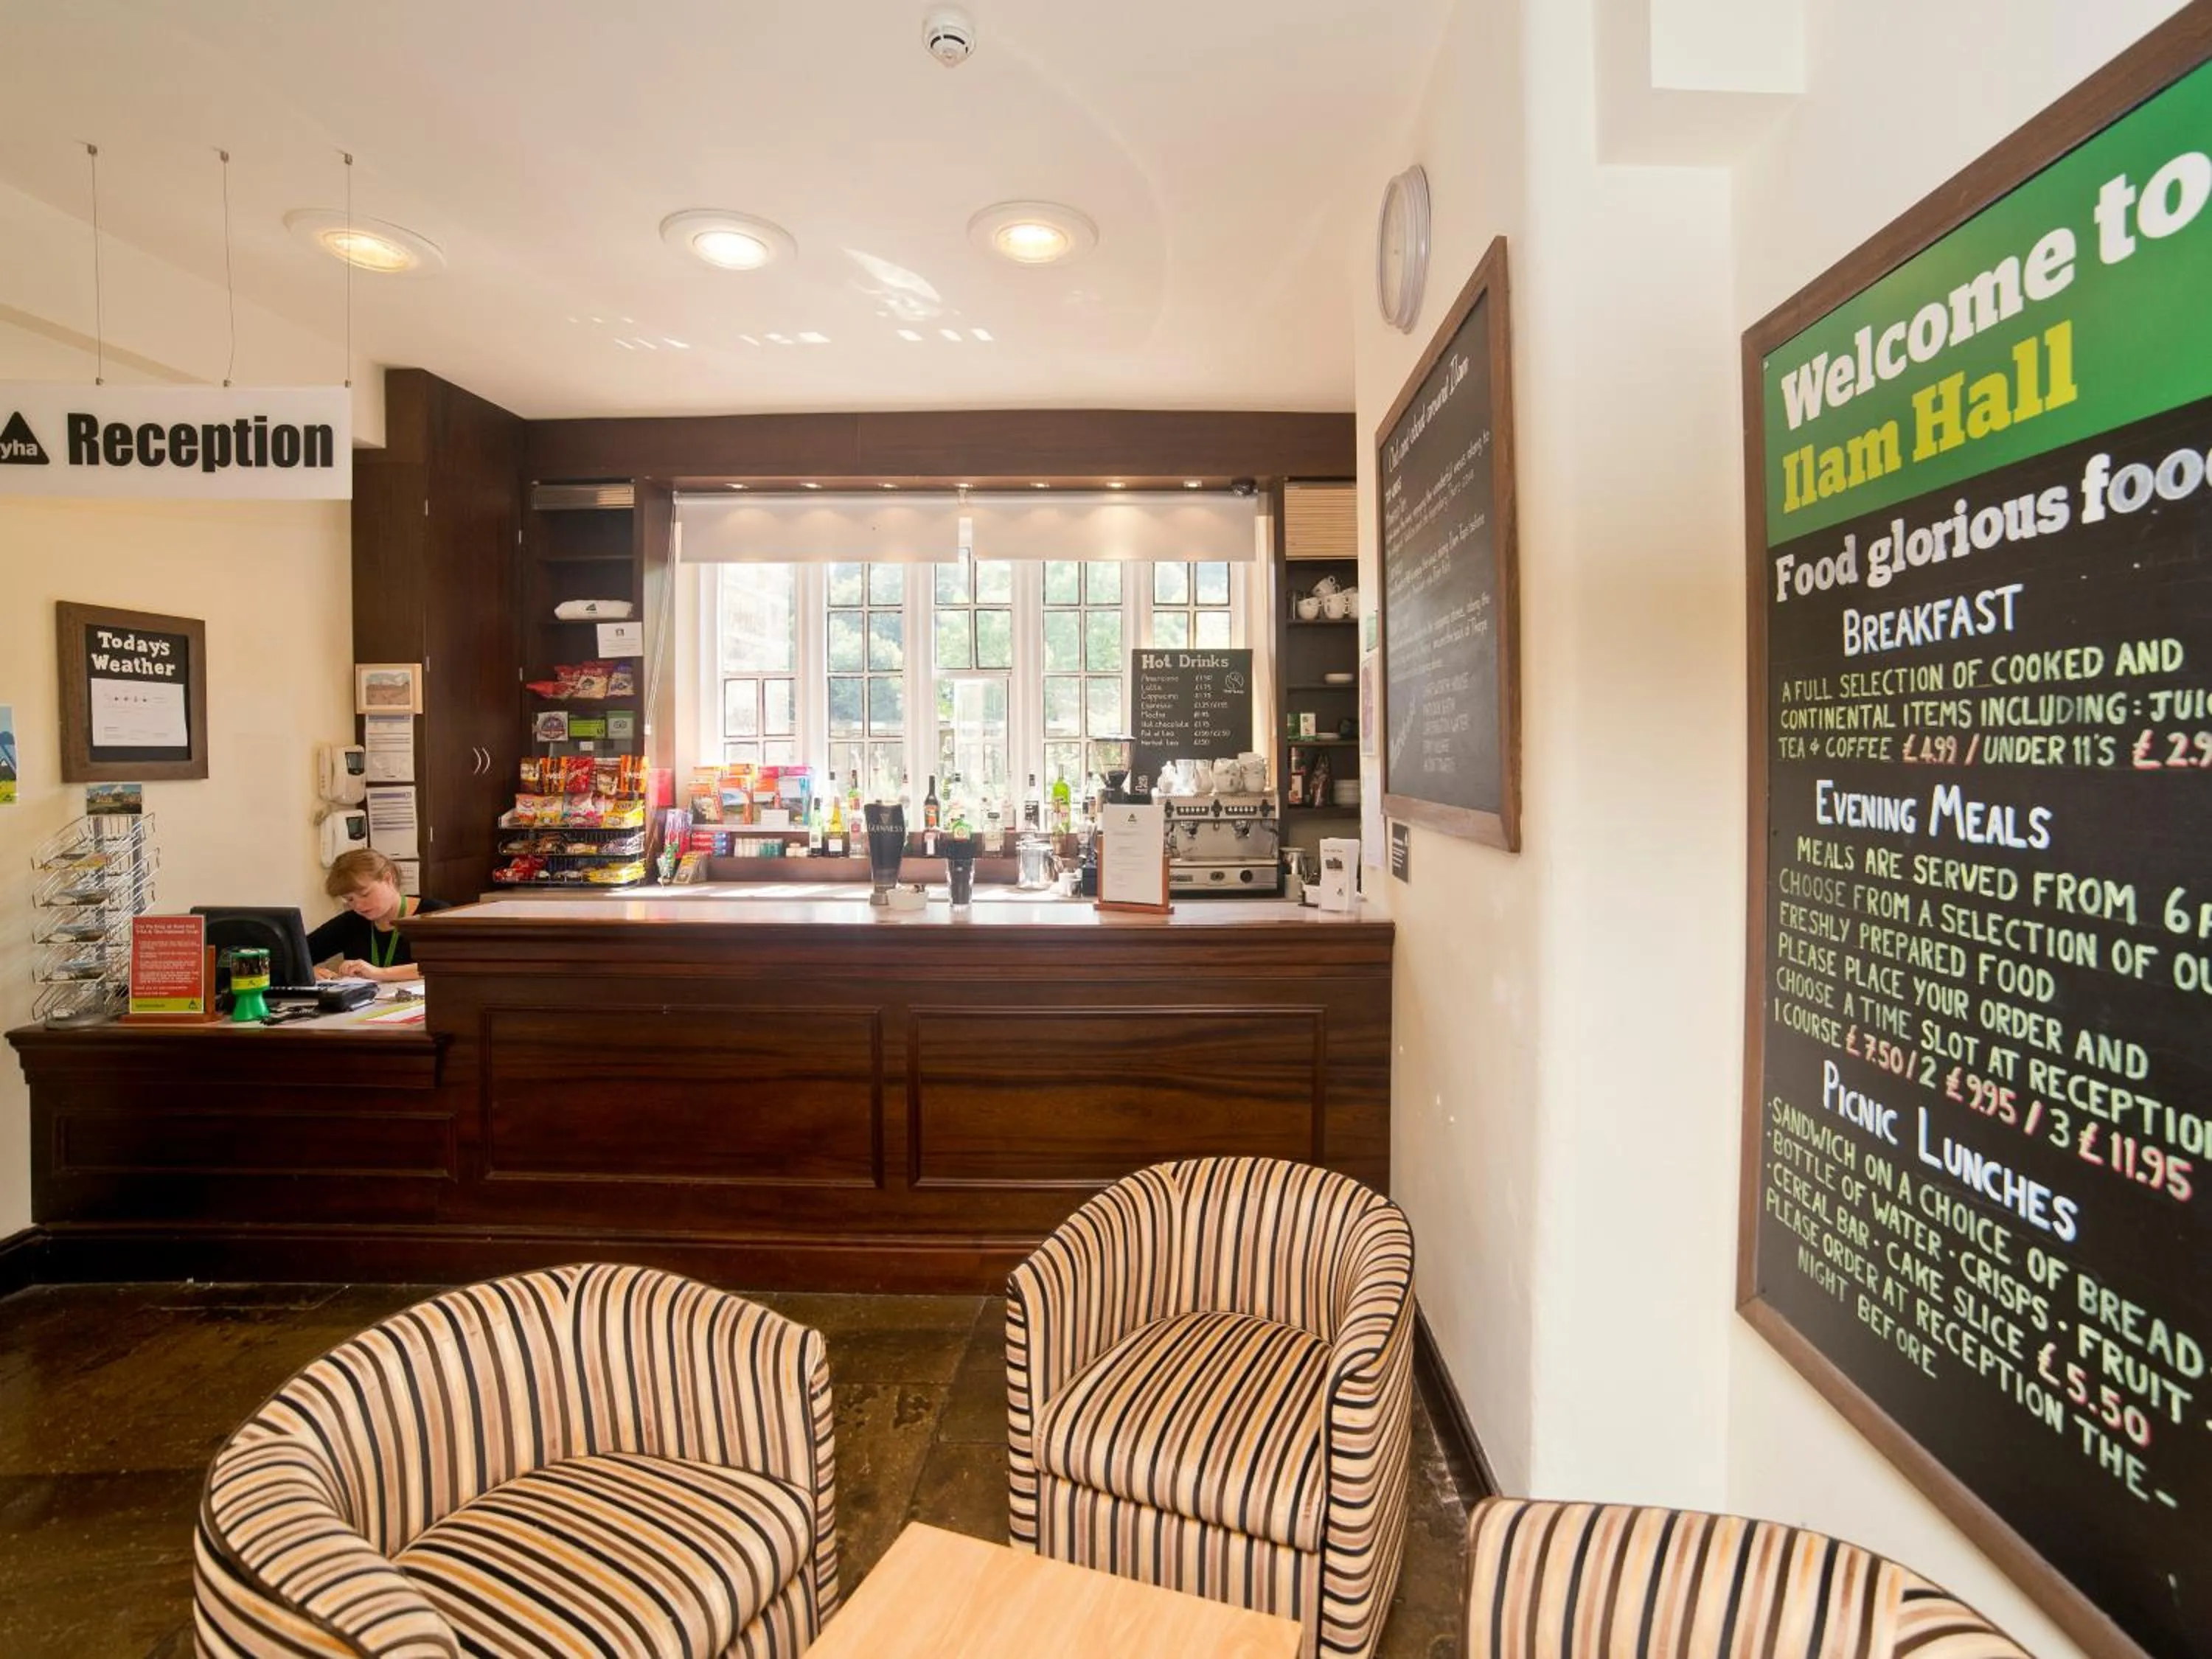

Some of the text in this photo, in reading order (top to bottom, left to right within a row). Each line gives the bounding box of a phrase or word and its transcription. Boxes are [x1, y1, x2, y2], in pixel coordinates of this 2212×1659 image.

[1781, 152, 2212, 431] Welcome to
[0, 439, 38, 460] yha
[68, 412, 334, 473] Reception
[1783, 320, 2078, 514] Ilam Hall
[1775, 448, 2212, 602] Food glorious foo
[91, 653, 176, 676] Weather
[1141, 654, 1230, 669] Hot Drinks
[1781, 638, 2184, 703] A FULL SELECTION OF COOKED AND
[1843, 583, 2023, 656] BREAKFAST
[1778, 736, 1805, 759] TEA
[1825, 736, 1893, 760] COFFEE
[1983, 735, 2066, 765] UNDER
[1781, 703, 1896, 731] CONTINENTAL
[1903, 699, 1972, 729] ITEMS
[868, 824, 905, 833] GUINNESS
[1816, 779, 2053, 849] EVENING MEALS
[1779, 868, 1846, 908] CHOOSE
[1854, 884, 1910, 922] FROM
[1919, 900, 1934, 928] A
[1940, 903, 2097, 969] SELECTION
[2112, 939, 2159, 979] OF
[1797, 835, 1854, 871] MEALS
[1865, 847, 1904, 880] ARE
[1913, 854, 2018, 901] SERVED
[2034, 871, 2137, 926] FROM
[1778, 932, 2149, 1080] PLEASE PLACE YOUR ORDER AND
[1780, 901, 2055, 1003] FRESHLY PREPARED FOOD
[1776, 966, 1834, 1009] CHOOSE
[1843, 992, 1854, 1018] A
[1860, 995, 1912, 1041] TIME
[1921, 1019, 1980, 1066] SLOT
[1988, 1046, 2020, 1081] AT
[1783, 1002, 1842, 1048] COURSE
[2048, 1108, 2070, 1148] 3
[2078, 1121, 2194, 1202] £11.95
[1823, 1060, 2079, 1242] PICNIC LUNCHES
[1772, 1096, 2205, 1379] SANDWICH ON A CHOICE OF BREAD
[1773, 1162, 1833, 1225] CEREAL
[1837, 1206, 1869, 1251] BAR
[1886, 1242, 1944, 1303] CAKE
[1953, 1286, 2025, 1360] SLICE
[1773, 1130, 2194, 1425] BOTTLE OF WATER CRISPS FRUIT
[1766, 1187, 1818, 1248] PLEASE
[1823, 1233, 1879, 1294] ORDER
[1882, 1276, 1909, 1313] AT
[1917, 1297, 2064, 1434] RECEPTION
[1798, 1245, 1938, 1379] NIGHT BEFORE
